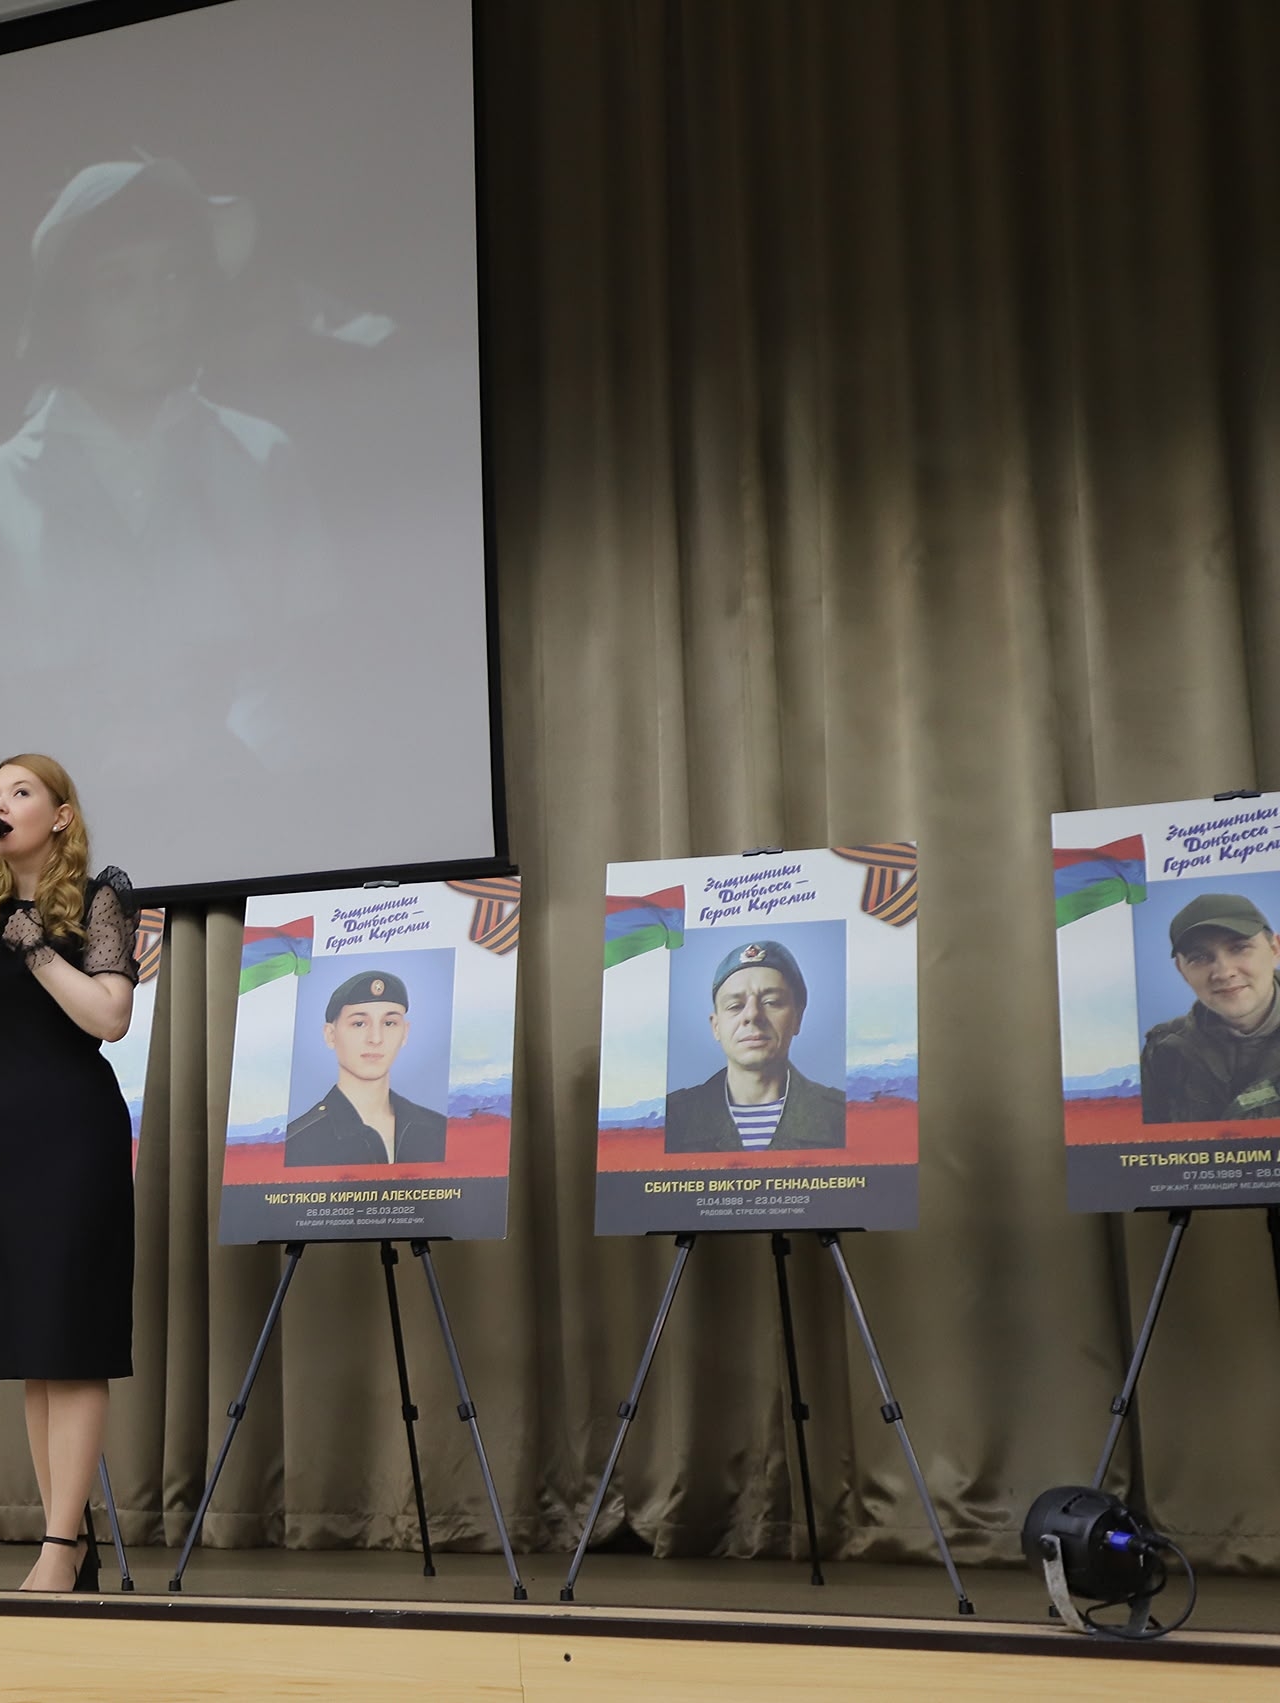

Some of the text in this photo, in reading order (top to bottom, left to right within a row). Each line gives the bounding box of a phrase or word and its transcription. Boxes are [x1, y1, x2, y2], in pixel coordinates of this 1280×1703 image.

[1166, 808, 1278, 841] Защитники
[1184, 826, 1268, 852] Донбасса
[1164, 855, 1211, 877] Герои
[704, 864, 801, 892] Защитники
[718, 881, 791, 903] Донбасса
[331, 896, 418, 922] Защитники
[700, 891, 816, 925] Герои Карелии
[344, 912, 408, 932] Донбасса
[326, 921, 430, 953] Герои Карелии
[1120, 1152, 1209, 1166] ТРЕТЬЯКОВ
[1215, 1150, 1271, 1163] ВАДИМ
[645, 1177, 865, 1193] СБИТНЕВ ВИКТОР ГЕННАДЬЕВИЧ
[1183, 1170, 1242, 1180] 07.05.1989
[265, 1189, 461, 1204] ЧИСТЯКОВ КИРИЛЛ АЛЕКСЕЕВИЧ
[1194, 1183, 1237, 1191] КОМАНДИР
[755, 1196, 810, 1204] 23.04.2023
